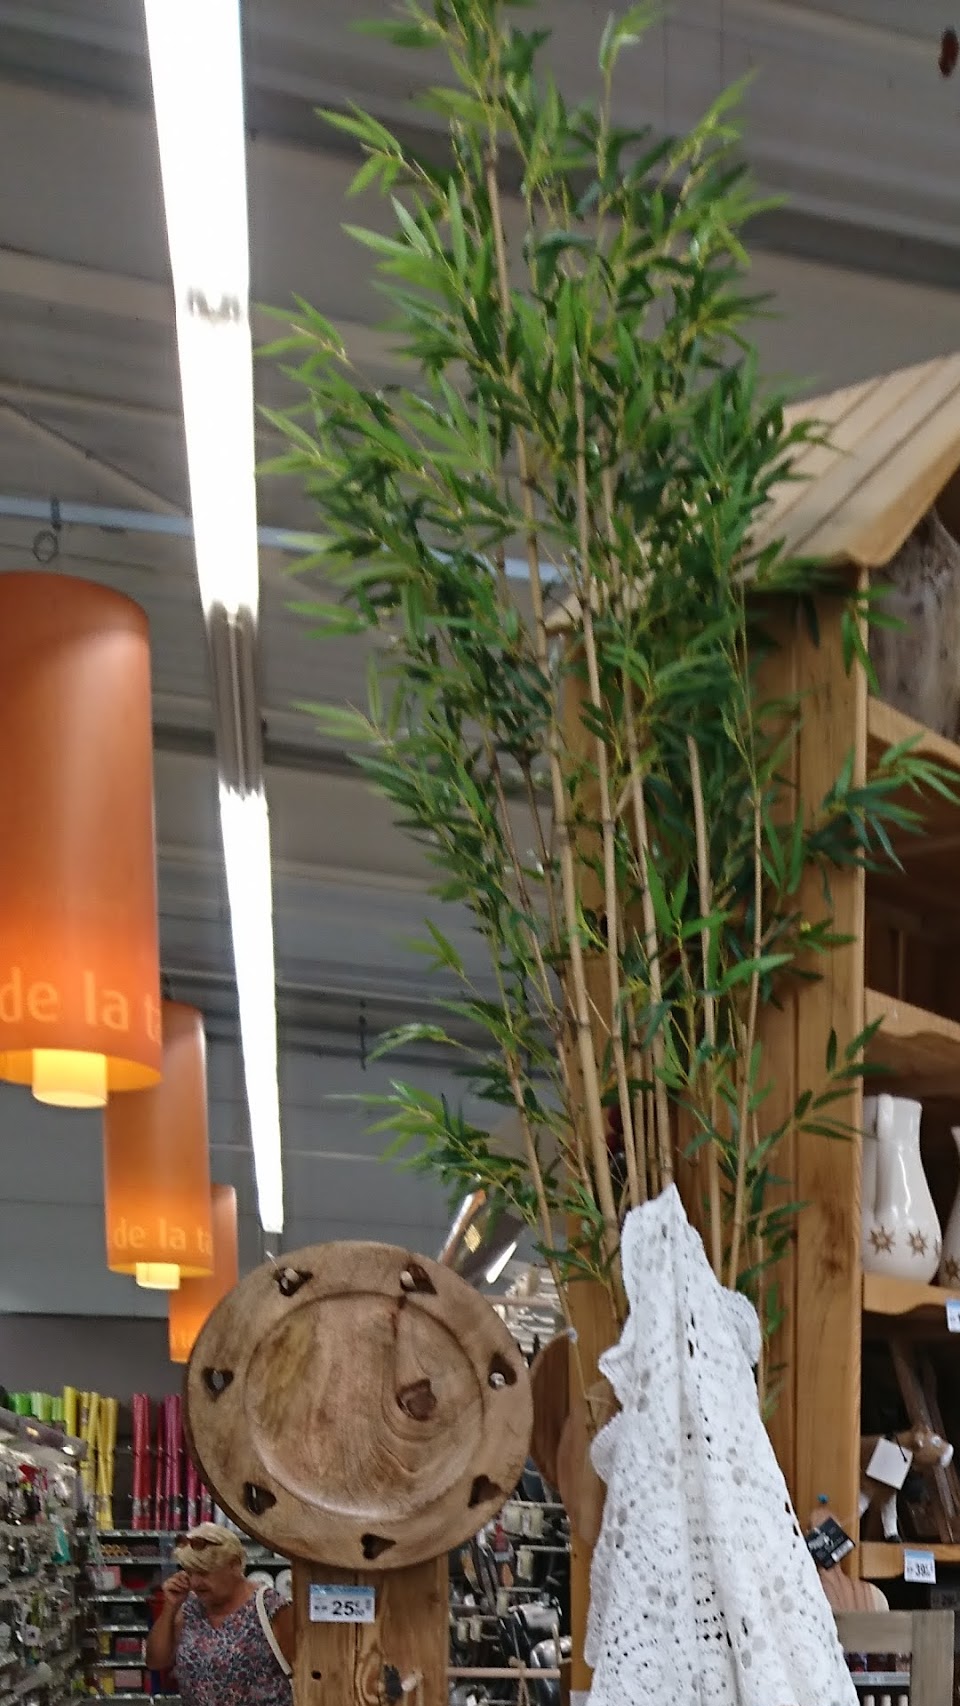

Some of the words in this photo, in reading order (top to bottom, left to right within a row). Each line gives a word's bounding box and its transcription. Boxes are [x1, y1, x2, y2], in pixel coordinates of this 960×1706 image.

[83, 971, 129, 1031] la
[113, 1217, 144, 1249] de
[159, 1218, 186, 1250] la
